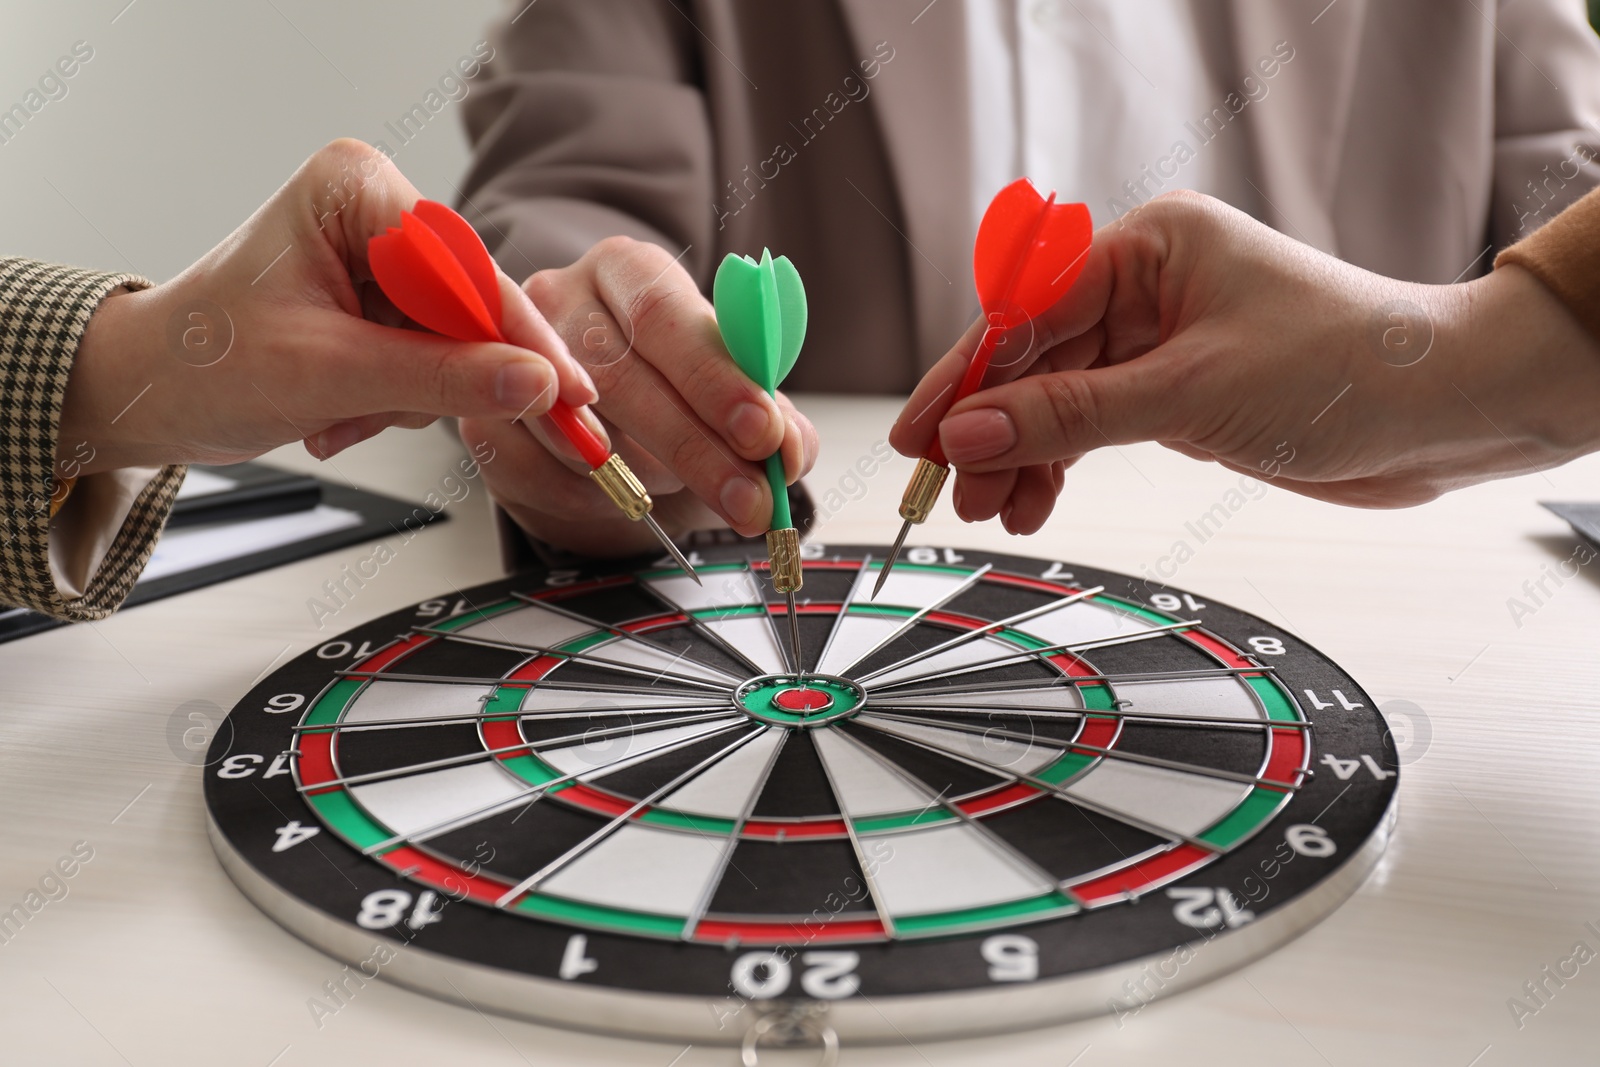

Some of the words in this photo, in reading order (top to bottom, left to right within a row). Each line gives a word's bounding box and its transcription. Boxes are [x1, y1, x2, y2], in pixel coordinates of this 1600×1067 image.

[907, 547, 964, 565] 19
[545, 570, 581, 586] 2
[1041, 562, 1074, 580] 7
[416, 600, 468, 616] 15
[1150, 593, 1206, 612] 16
[316, 640, 372, 659] 10
[1248, 636, 1286, 655] 8
[263, 693, 305, 714] 6
[1303, 689, 1364, 710] 11
[217, 754, 291, 779] 13
[1320, 754, 1396, 780] 14
[271, 821, 321, 852] 4
[1284, 823, 1337, 858] 9
[356, 889, 443, 930] 18
[1166, 887, 1255, 929] 12
[559, 933, 598, 981] 1
[980, 934, 1039, 982] 5
[730, 950, 861, 1000] 20
